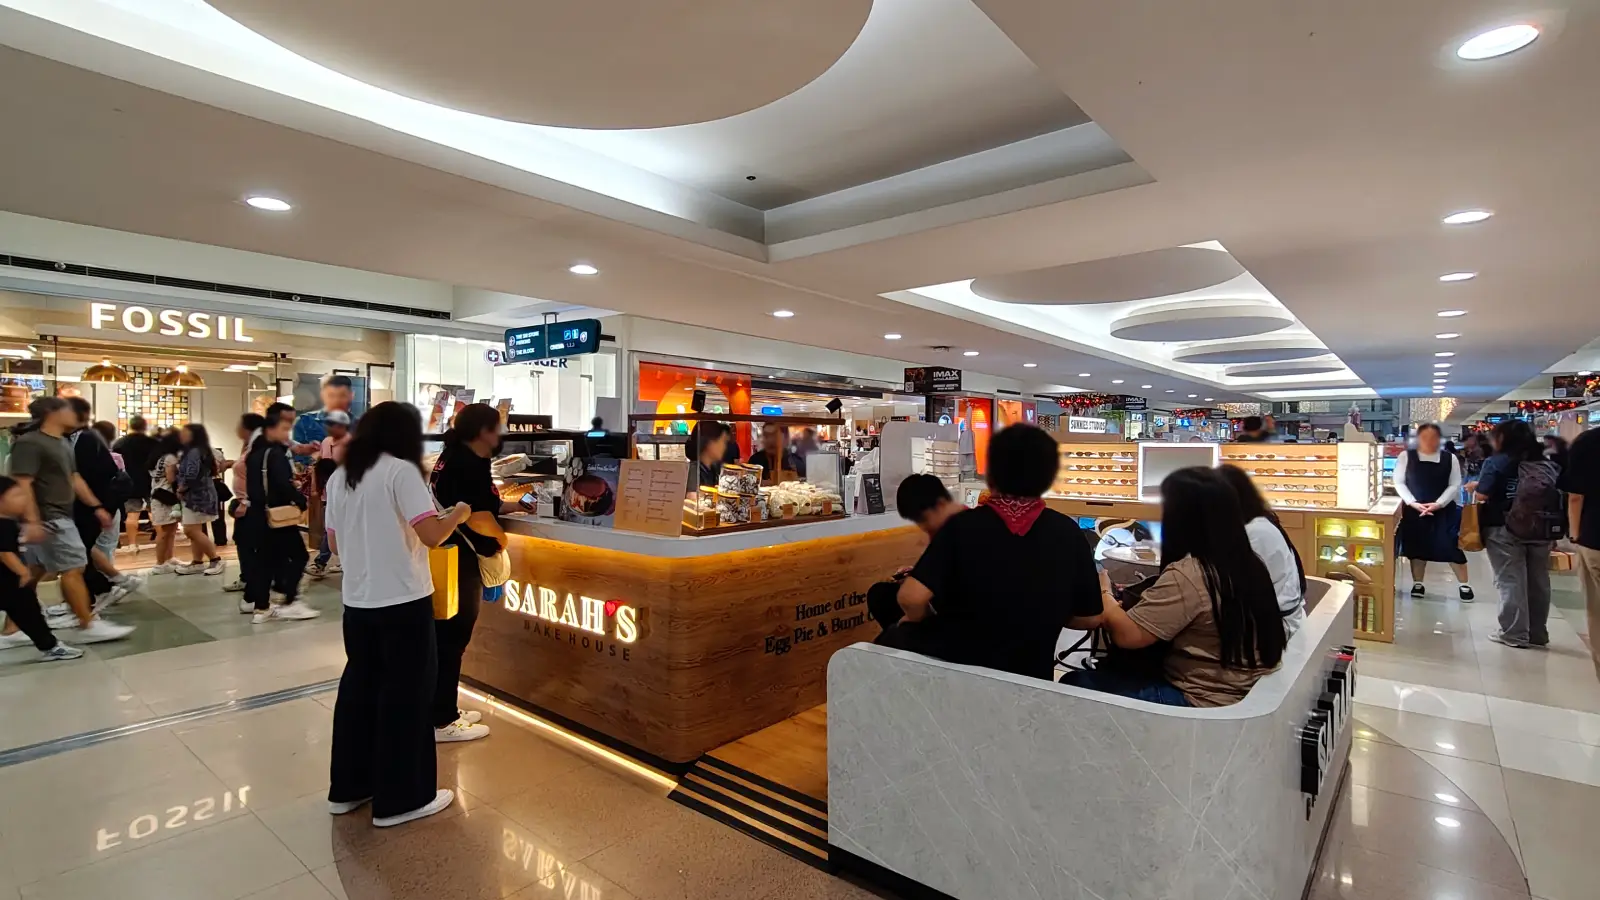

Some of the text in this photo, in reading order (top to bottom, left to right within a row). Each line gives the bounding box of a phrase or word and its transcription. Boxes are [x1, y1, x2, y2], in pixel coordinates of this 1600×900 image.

[91, 303, 254, 342] FOSSIL
[933, 370, 958, 378] IMAX
[1070, 420, 1106, 431] SUNNIES STUDIOS
[795, 591, 867, 621] Home of the
[523, 620, 630, 661] BAKE HOUSE
[764, 635, 792, 656] Egg
[794, 626, 814, 644] Pie
[816, 621, 828, 637] &
[831, 611, 865, 633] Burnt
